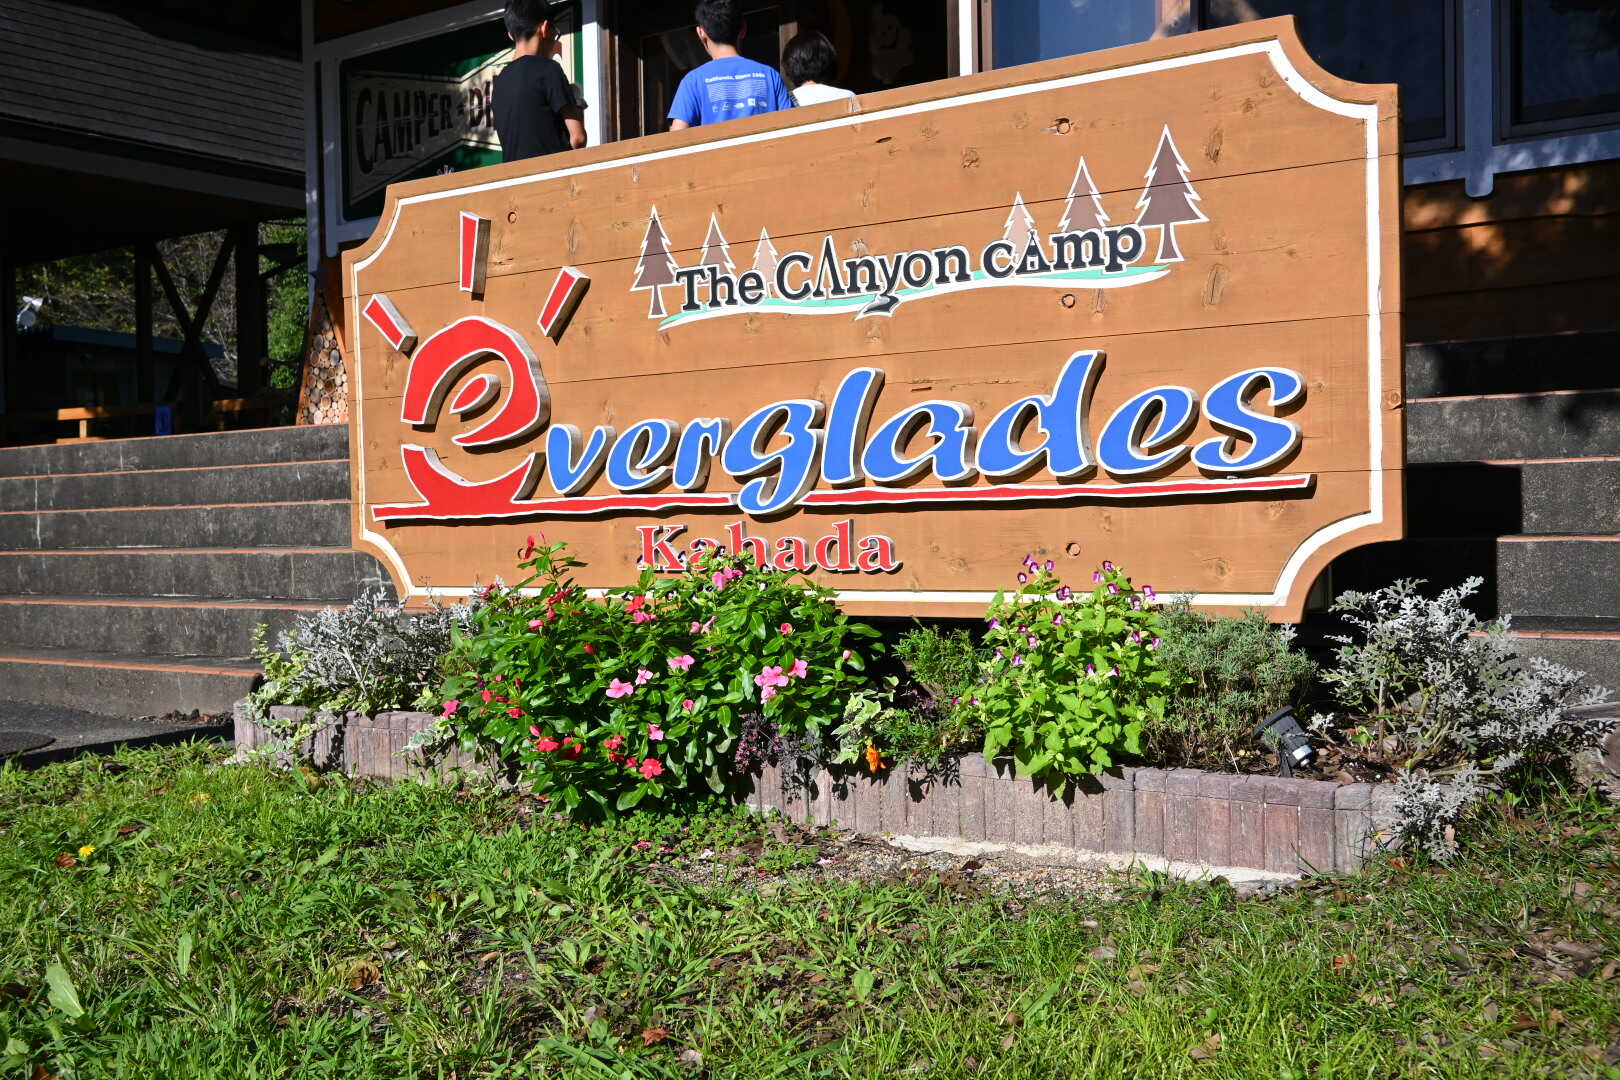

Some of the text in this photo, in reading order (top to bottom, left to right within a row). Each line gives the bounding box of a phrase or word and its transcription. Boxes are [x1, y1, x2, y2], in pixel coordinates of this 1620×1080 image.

[356, 87, 453, 175] CAMPER
[675, 265, 765, 312] The
[636, 519, 904, 573] Kahada
